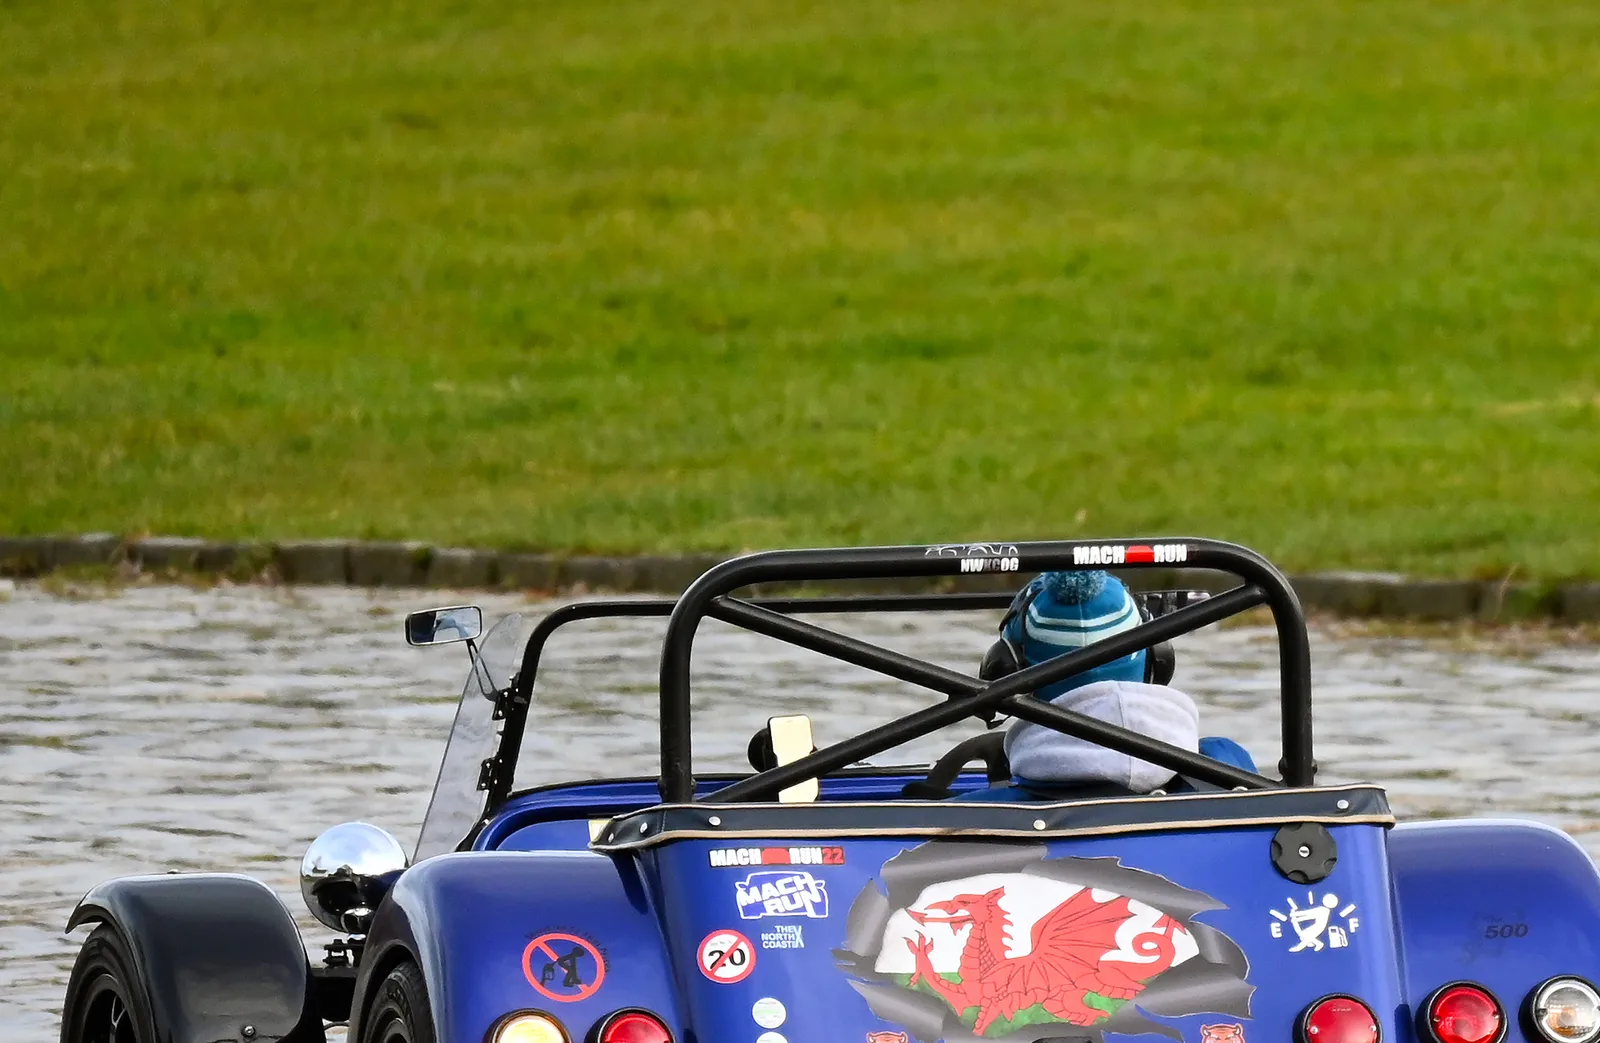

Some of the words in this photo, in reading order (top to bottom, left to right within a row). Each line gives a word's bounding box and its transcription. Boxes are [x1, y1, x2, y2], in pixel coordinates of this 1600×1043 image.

[1073, 545, 1126, 565] MACH
[1153, 544, 1187, 563] RUN
[960, 557, 1019, 573] NWKCOG
[709, 848, 762, 867] MACH
[739, 874, 816, 907] MACH
[763, 888, 822, 918] RUN
[774, 925, 795, 933] THE
[1271, 922, 1282, 938] E
[1349, 918, 1359, 933] F
[1485, 924, 1528, 939] 500
[761, 932, 795, 941] NORTH
[762, 940, 791, 949] COAST
[708, 948, 746, 969] 20
